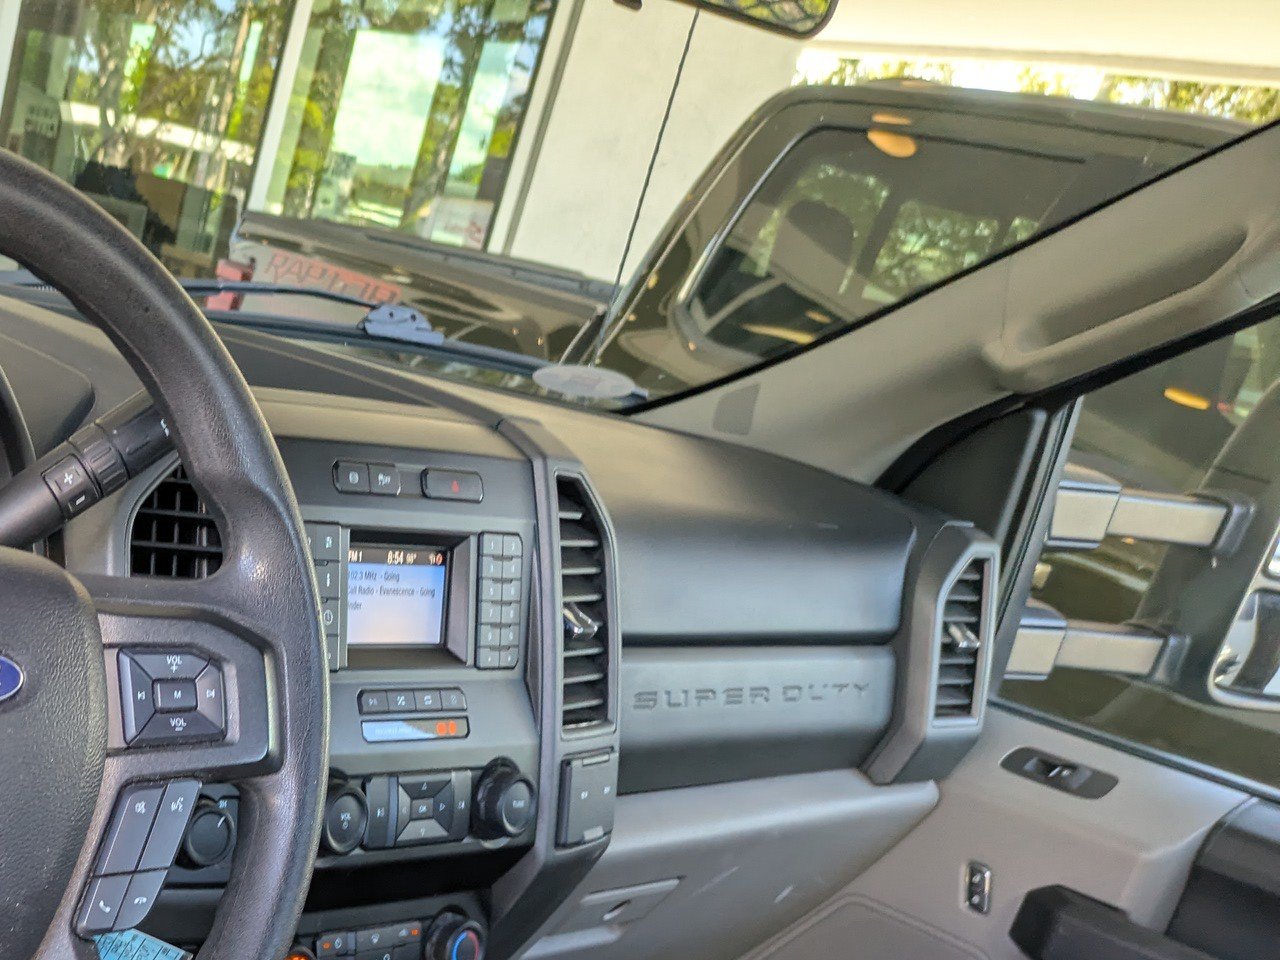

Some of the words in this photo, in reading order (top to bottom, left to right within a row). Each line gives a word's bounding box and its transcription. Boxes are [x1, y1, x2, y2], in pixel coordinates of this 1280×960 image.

[387, 550, 404, 565] 8:54
[166, 655, 183, 665] VOL
[174, 691, 182, 700] M
[632, 687, 771, 710] SUPER
[781, 682, 871, 703] DUTY
[170, 717, 187, 728] VOL
